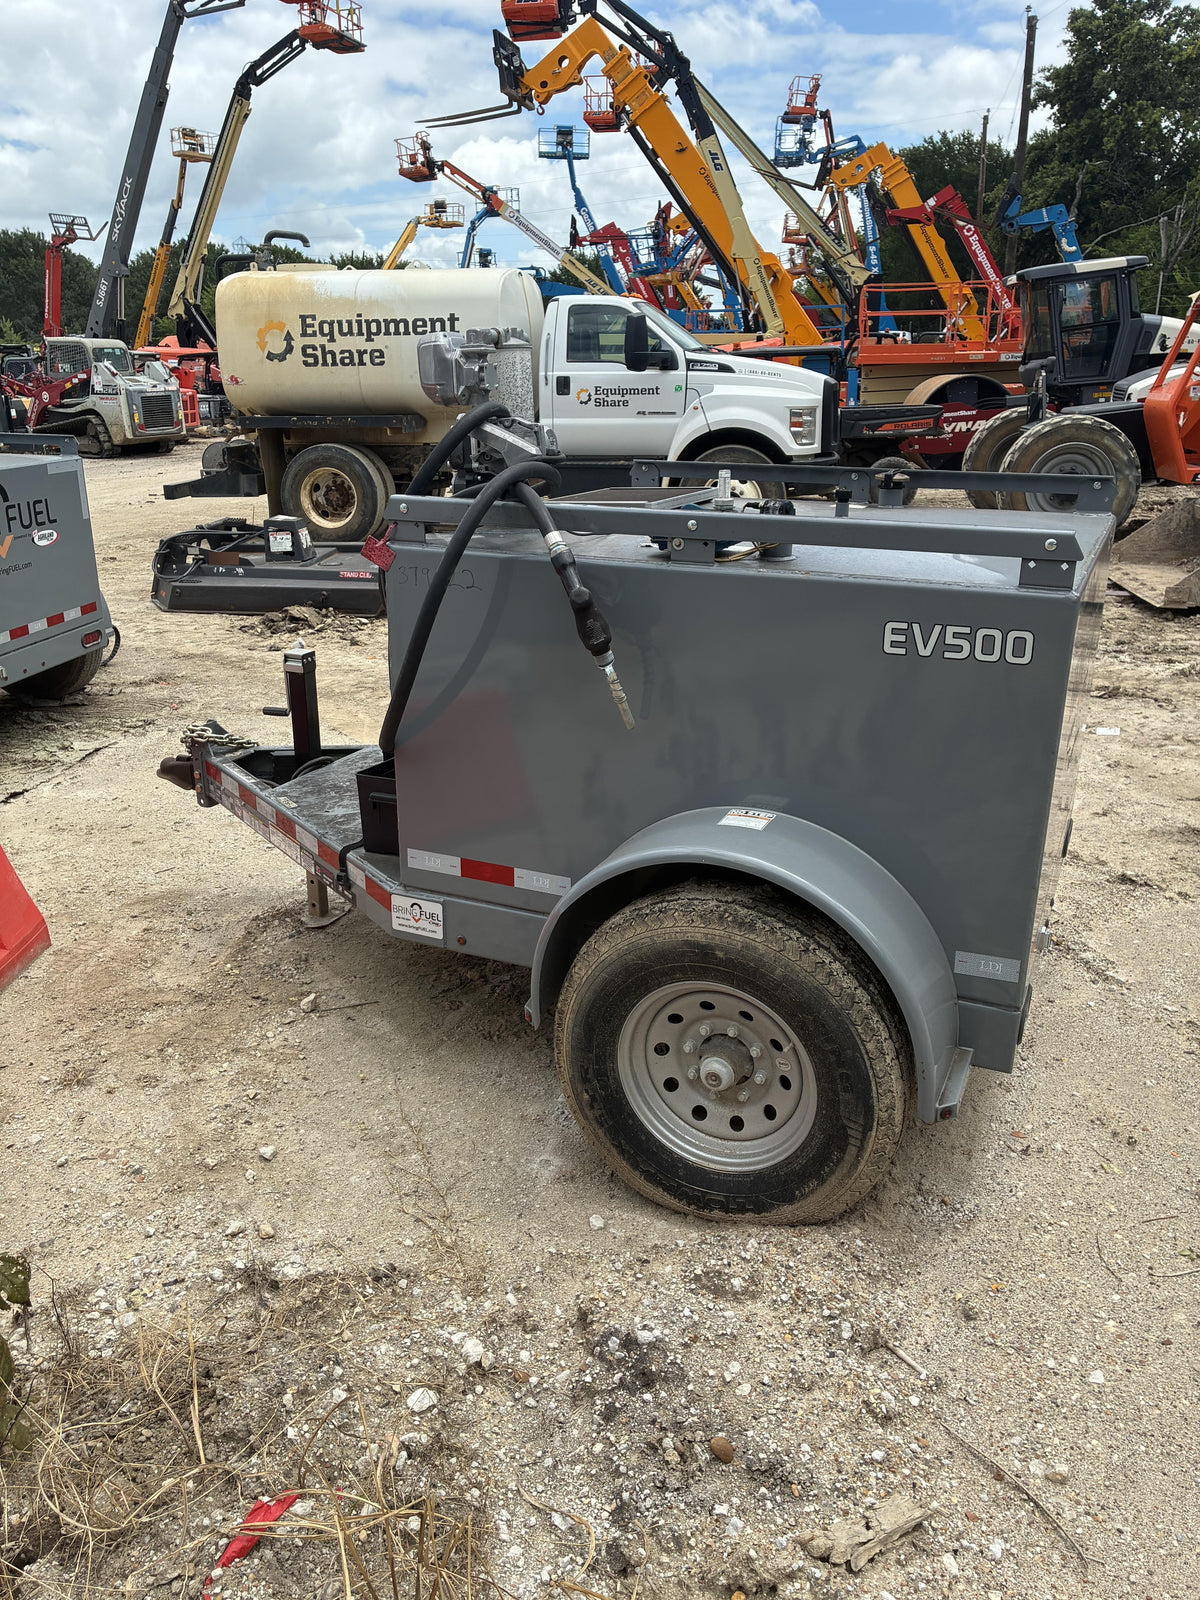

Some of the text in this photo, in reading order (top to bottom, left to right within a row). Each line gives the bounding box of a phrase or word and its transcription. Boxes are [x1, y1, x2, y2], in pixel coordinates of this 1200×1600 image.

[708, 149, 724, 172] JLG
[112, 176, 133, 242] SKYJACK
[580, 207, 595, 233] Genie
[514, 214, 561, 257] EquipmentShare
[919, 224, 950, 280] EquipmentShare
[96, 278, 109, 308] SJ66T
[584, 278, 598, 288] JLG
[756, 265, 779, 319] EquipmentShare
[299, 312, 460, 342] Equipment
[301, 344, 386, 368] Share
[594, 385, 660, 397] Equipment
[594, 398, 630, 408] Share
[894, 421, 932, 430] POLARIS
[943, 420, 987, 433] YNA
[5, 498, 58, 533] FUEL
[882, 620, 1035, 665] EV500
[392, 904, 418, 917] BRING
[419, 910, 442, 922] FUEL
